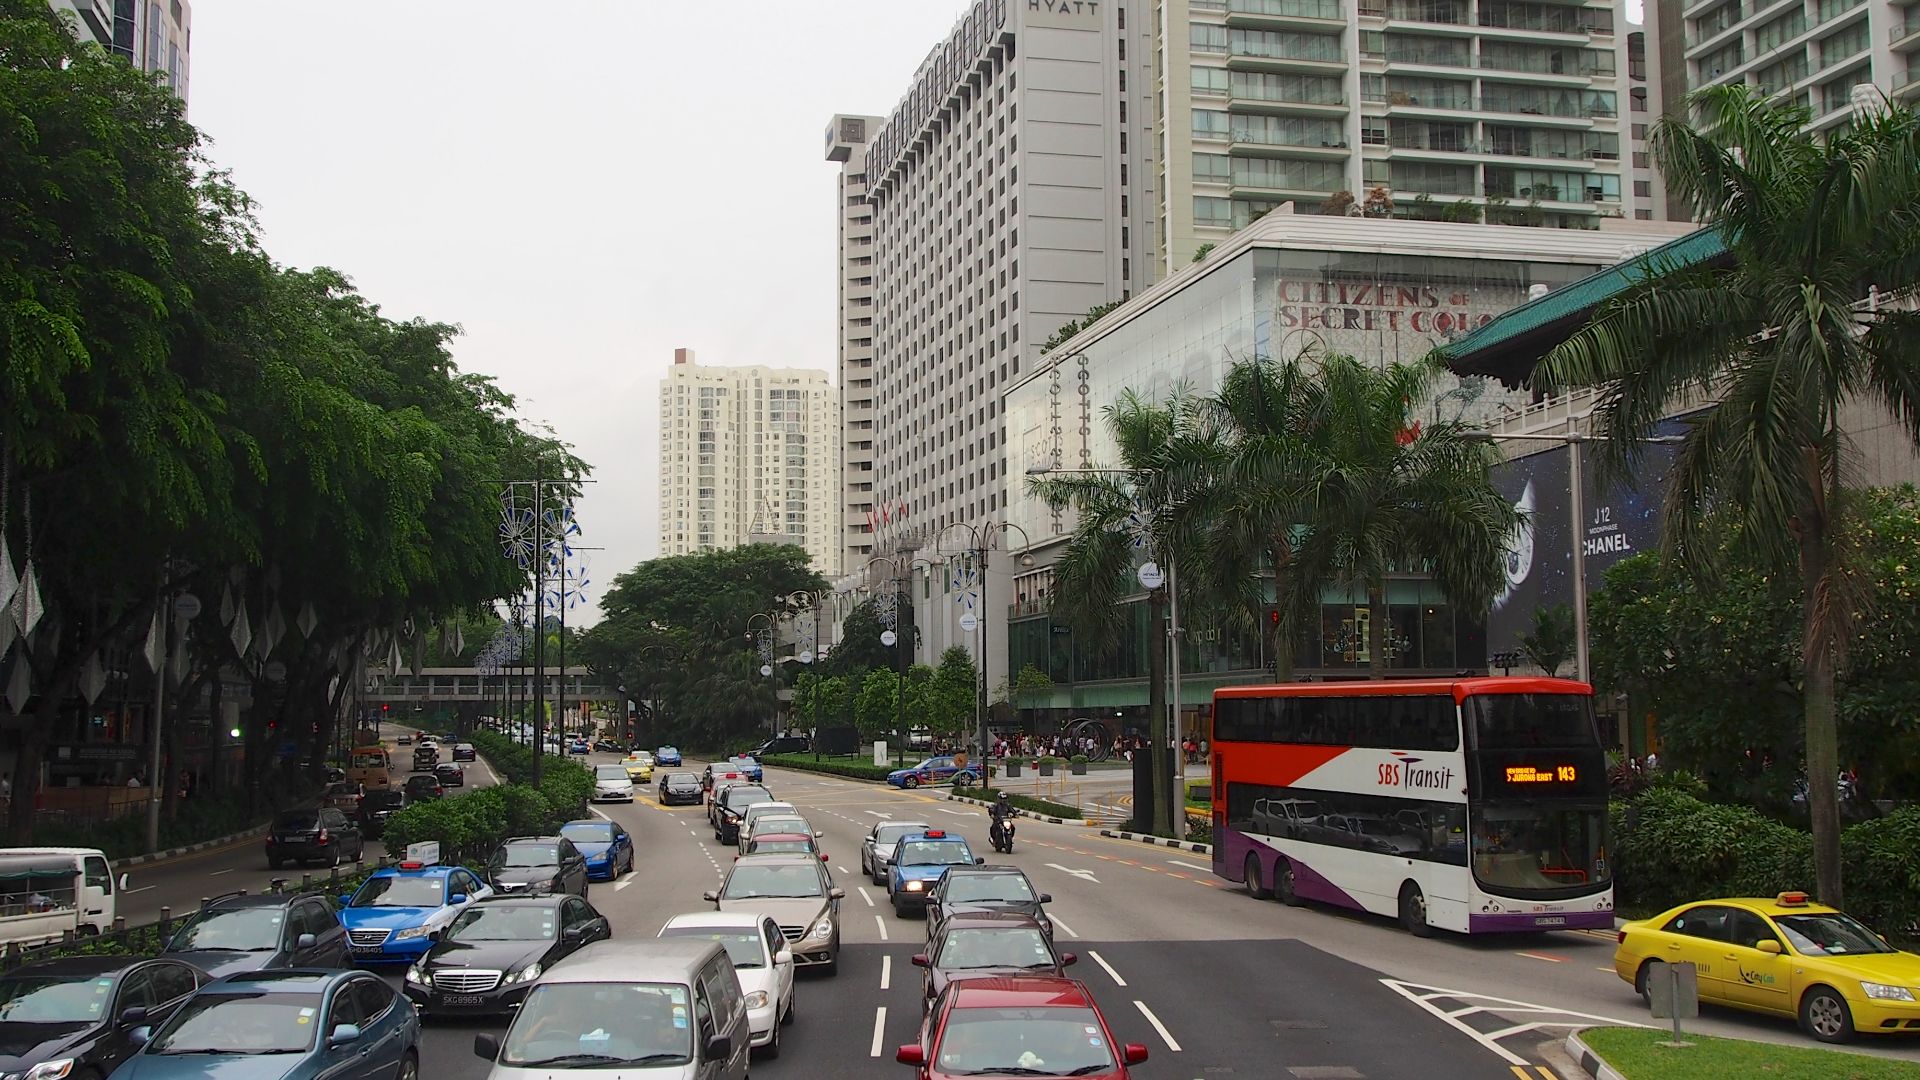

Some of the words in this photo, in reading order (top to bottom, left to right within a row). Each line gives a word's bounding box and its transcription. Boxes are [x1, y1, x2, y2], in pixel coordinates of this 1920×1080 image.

[1029, 0, 1099, 16] HYATT
[1279, 281, 1439, 309] CITIZENS
[1280, 304, 1404, 332] SECRET
[1377, 763, 1399, 786] SBS
[1399, 758, 1455, 791] Transit
[1536, 772, 1553, 782] EAST
[1557, 766, 1576, 781] 143
[443, 996, 483, 1004] SKG8965X
